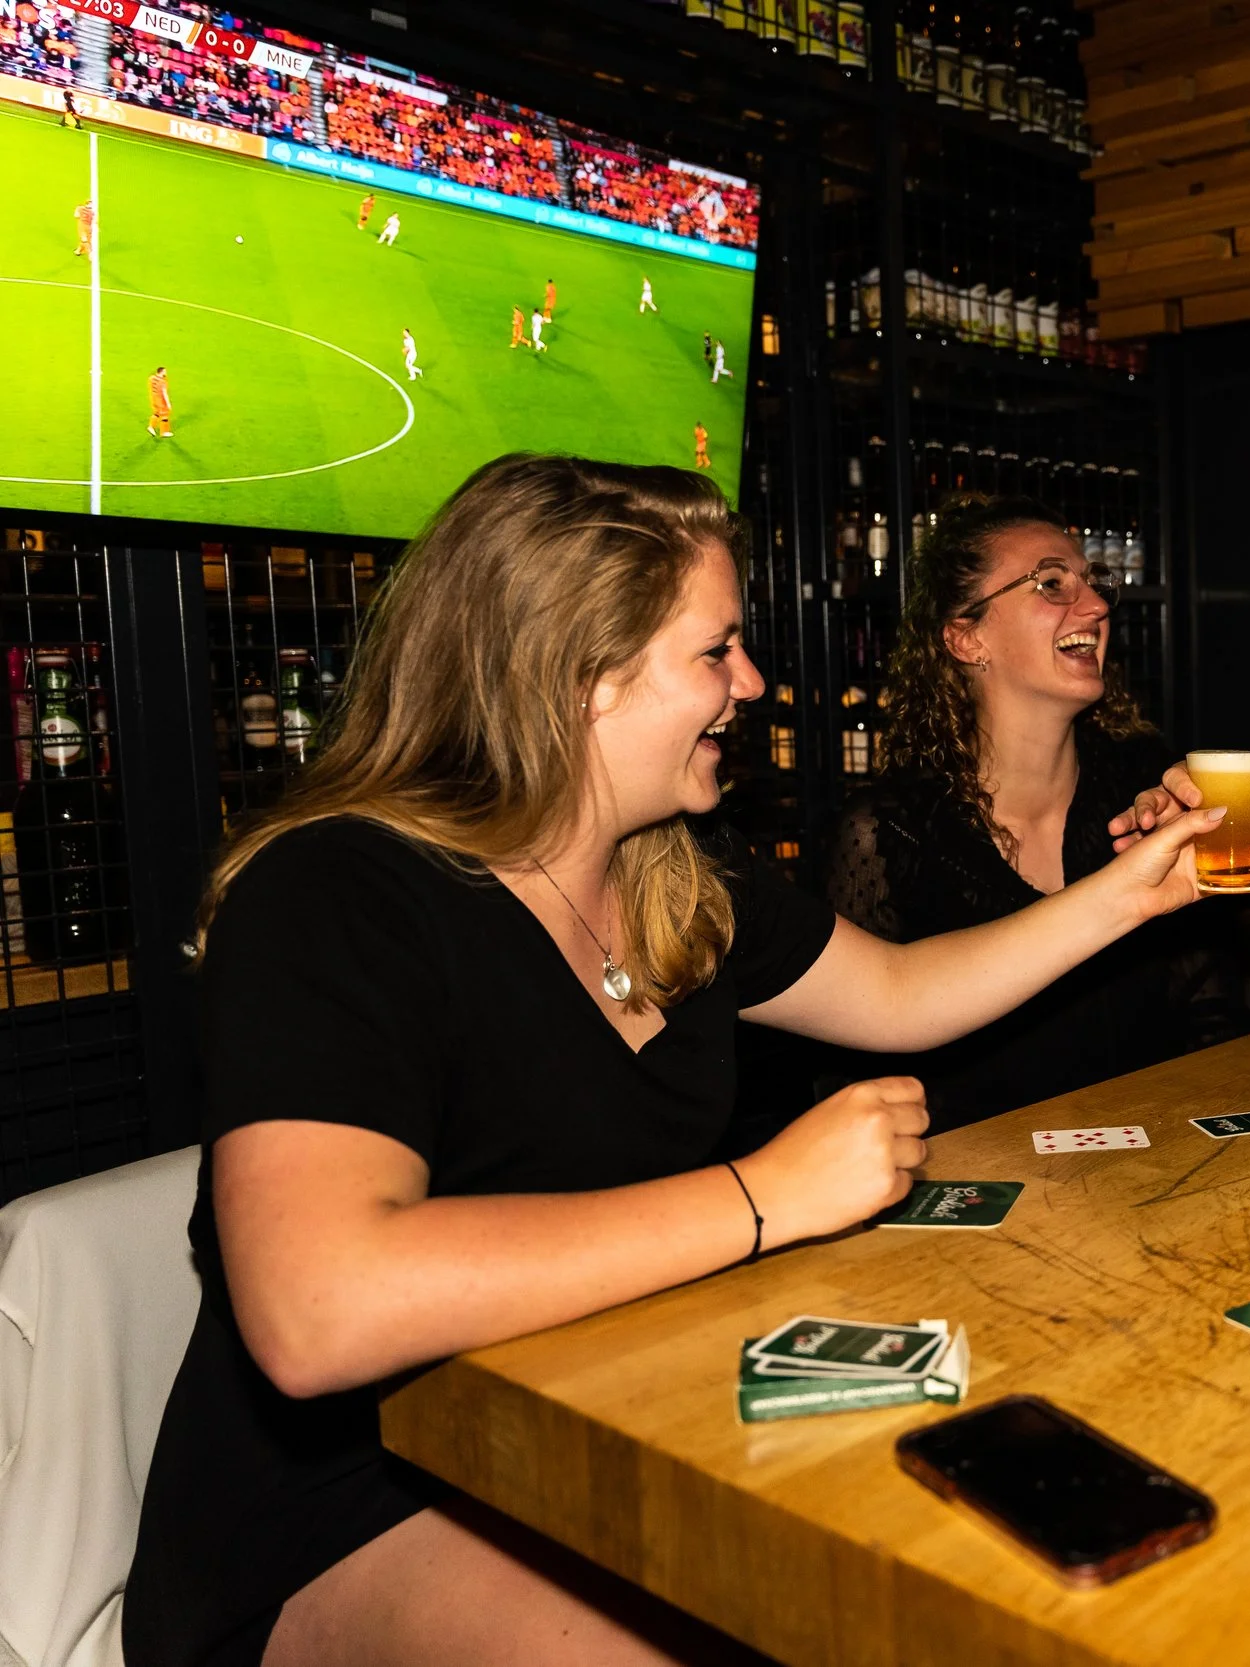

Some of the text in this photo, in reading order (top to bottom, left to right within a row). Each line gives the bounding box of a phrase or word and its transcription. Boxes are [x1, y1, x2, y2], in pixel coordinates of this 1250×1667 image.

[145, 12, 181, 34] NED
[267, 49, 302, 72] MNE
[169, 120, 213, 144] ING
